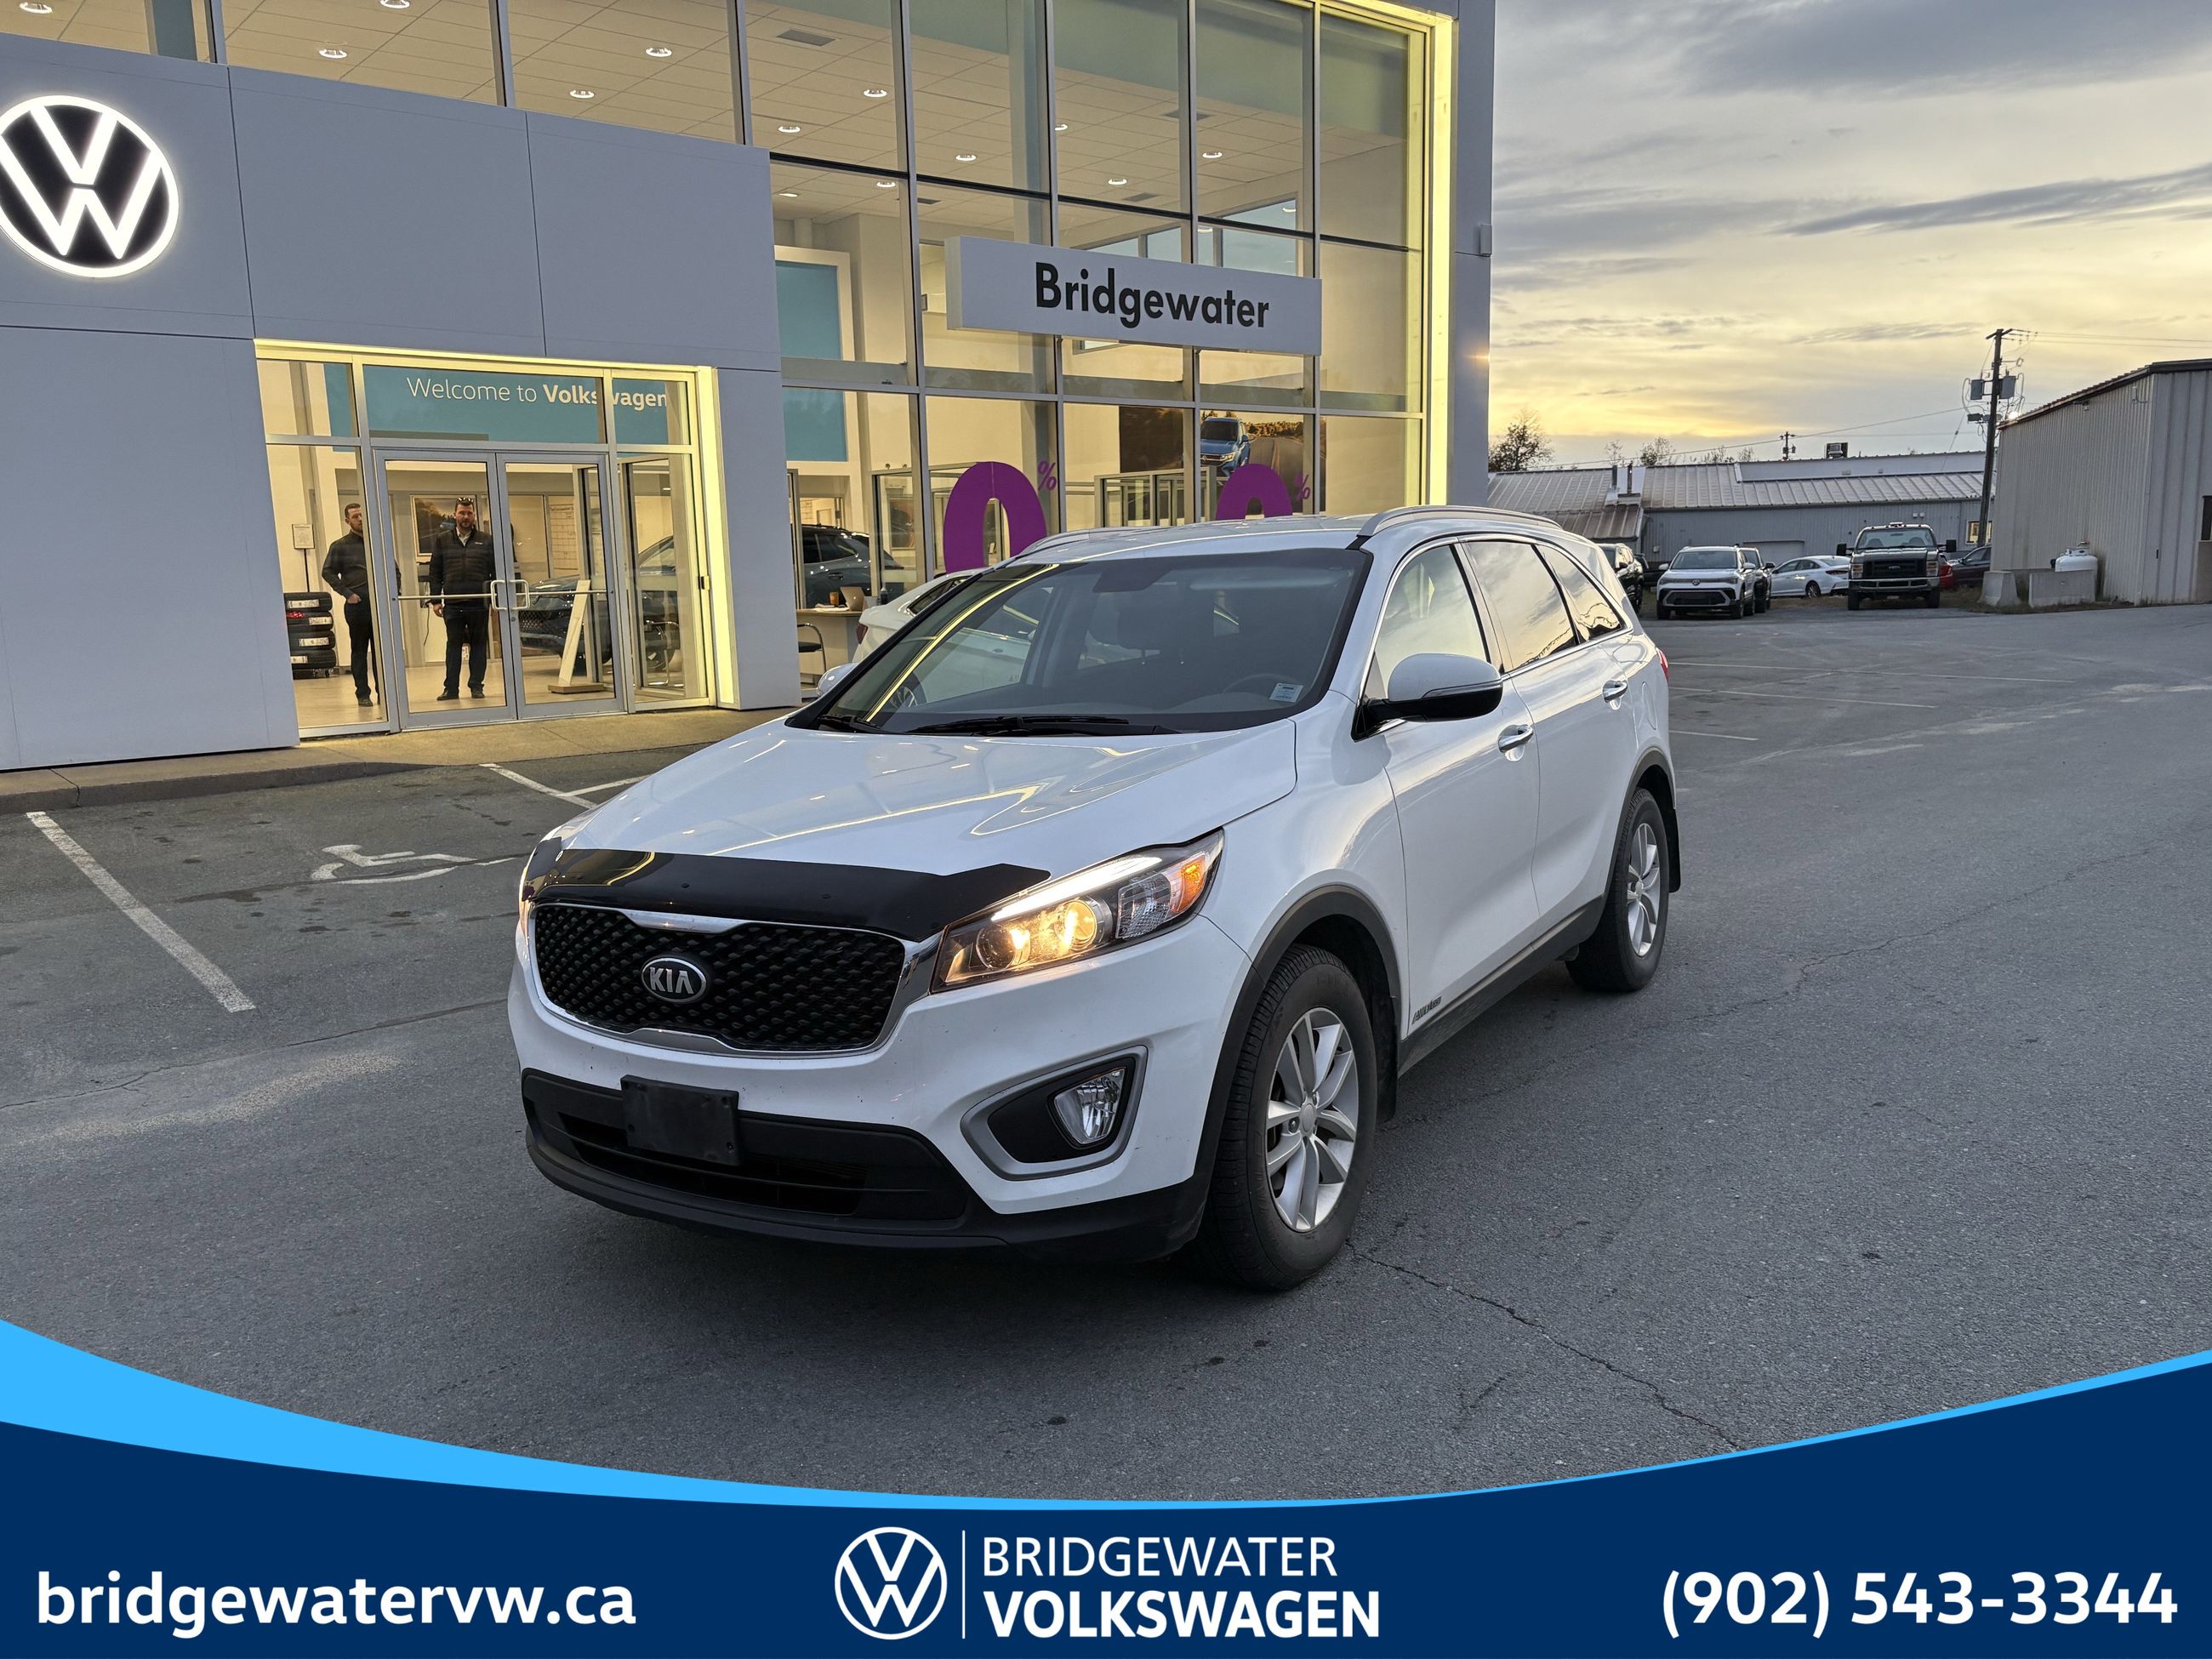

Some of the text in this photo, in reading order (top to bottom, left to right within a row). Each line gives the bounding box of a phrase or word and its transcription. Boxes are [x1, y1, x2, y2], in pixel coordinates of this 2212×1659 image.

[1035, 261, 1270, 328] Bridgewater
[407, 377, 510, 401] Welcome
[516, 385, 538, 402] to
[649, 966, 695, 995] KIA
